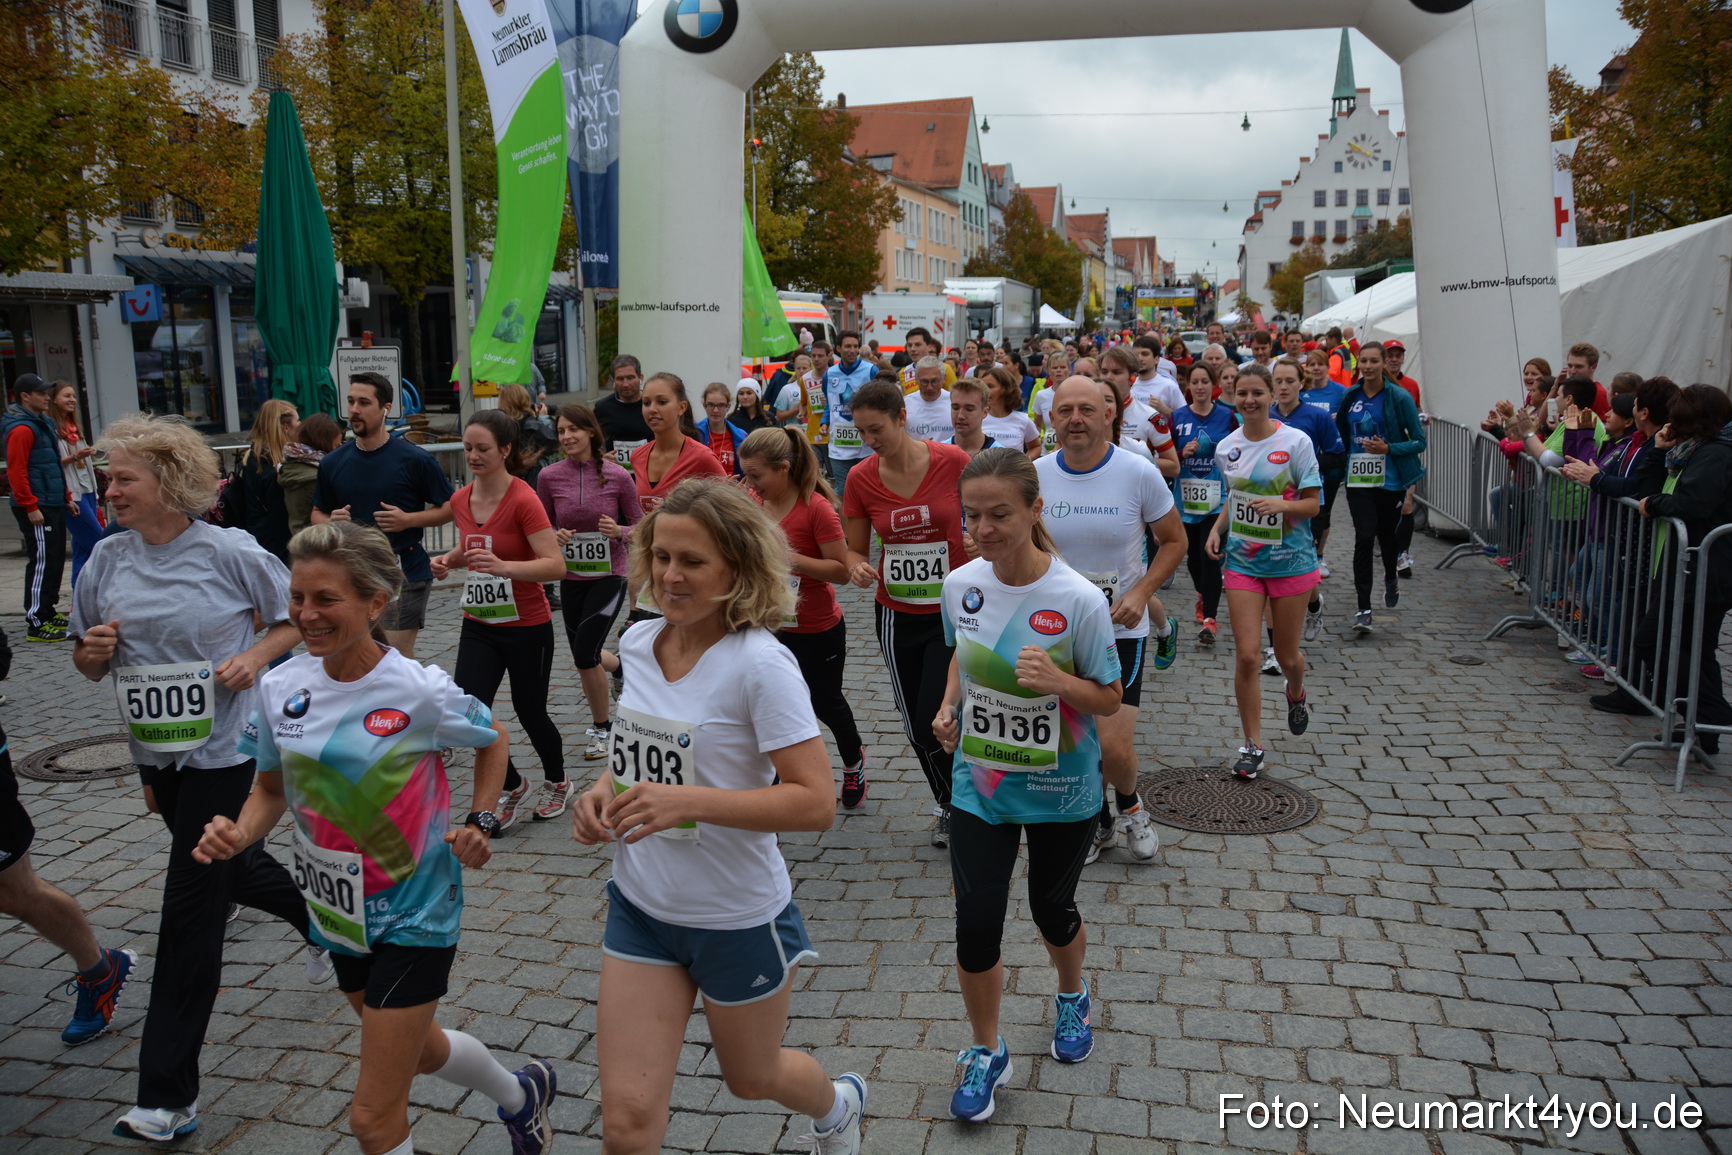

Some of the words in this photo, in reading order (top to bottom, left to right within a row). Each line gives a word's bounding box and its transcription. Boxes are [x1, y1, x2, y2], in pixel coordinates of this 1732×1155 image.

[492, 26, 548, 66] Lammsbräu
[563, 64, 607, 95] THE
[167, 232, 191, 251] City
[1440, 275, 1557, 294] www.bmw-laufsport.de
[621, 302, 720, 313] www.bmw-laufsport.de
[340, 355, 370, 364] Fußgänger
[372, 355, 397, 364] Richtung
[350, 364, 387, 372] Lammsbräu-
[831, 377, 840, 388] 9
[837, 429, 859, 439] 5057
[1176, 423, 1192, 436] 11
[1352, 462, 1382, 474] 5005
[1184, 487, 1207, 501] 5138
[900, 514, 916, 522] 2015
[1073, 506, 1120, 516] NEUMARKT
[1240, 526, 1271, 538] Elisabeth
[565, 543, 605, 560] 5189
[890, 557, 944, 581] 5034
[466, 582, 508, 605] 5084
[906, 587, 927, 596] Julia
[479, 608, 497, 617] Julia
[959, 616, 979, 626] PARTL
[1034, 614, 1063, 629] Hervis
[120, 675, 146, 683] PARTL
[148, 672, 195, 682] Neumarkt
[127, 684, 206, 719] 5009
[968, 688, 995, 706] PARTL
[996, 699, 1042, 713] Neumarkt
[277, 723, 304, 732] PARTL
[370, 714, 405, 730] Hervis
[972, 704, 1051, 745] 5136
[140, 726, 197, 740] Katharina
[631, 722, 674, 743] Neumarkt
[612, 734, 684, 785] 5193
[984, 744, 1031, 763] Claudia
[1027, 774, 1080, 783] Neumarkter
[1026, 782, 1070, 793] Stadtlauf
[293, 852, 354, 915] 5090
